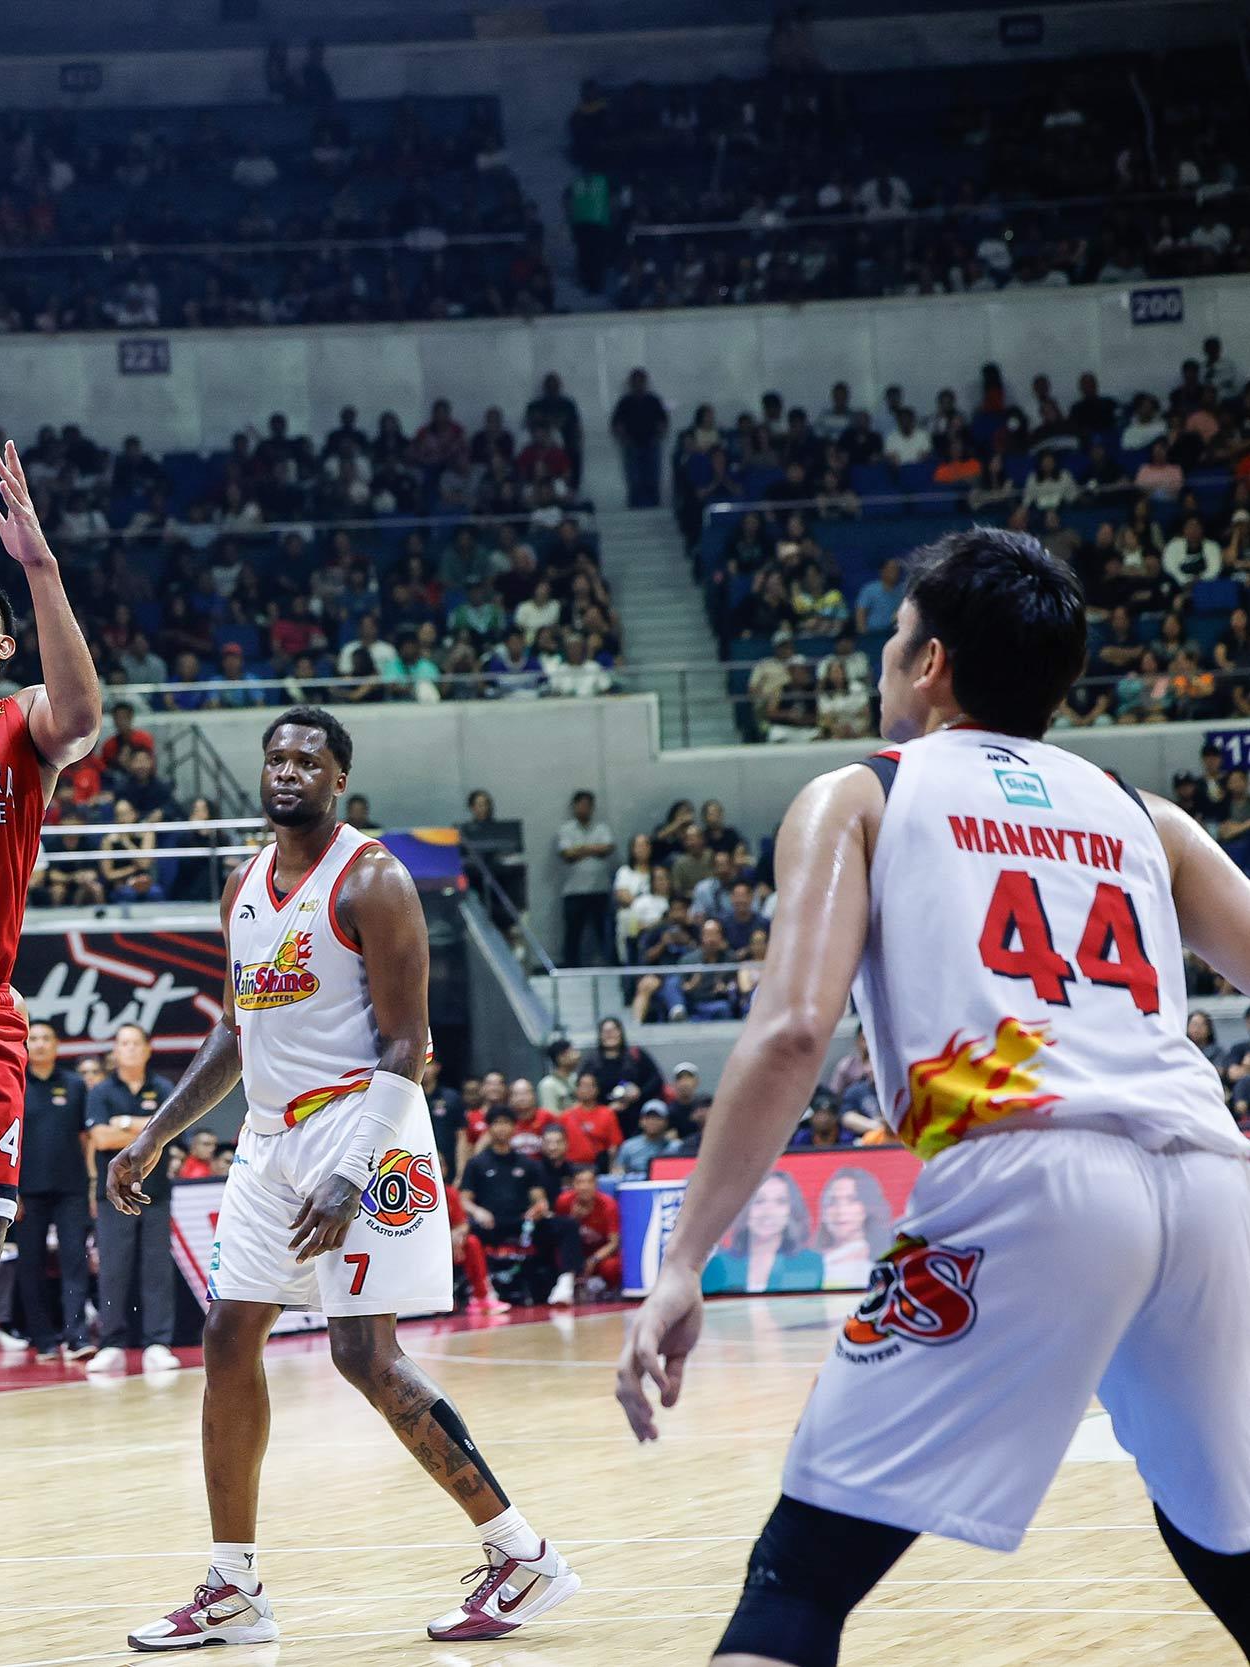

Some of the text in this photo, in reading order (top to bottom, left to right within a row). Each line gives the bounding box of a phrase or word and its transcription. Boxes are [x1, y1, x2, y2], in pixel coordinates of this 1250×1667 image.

[1132, 293, 1181, 320] 200
[947, 815, 1124, 873] MANAYTAY
[978, 869, 1160, 1016] 44
[26, 961, 200, 1041] Hut
[366, 1215, 424, 1238] ELASTO PAINTERS
[344, 1252, 370, 1296] 7
